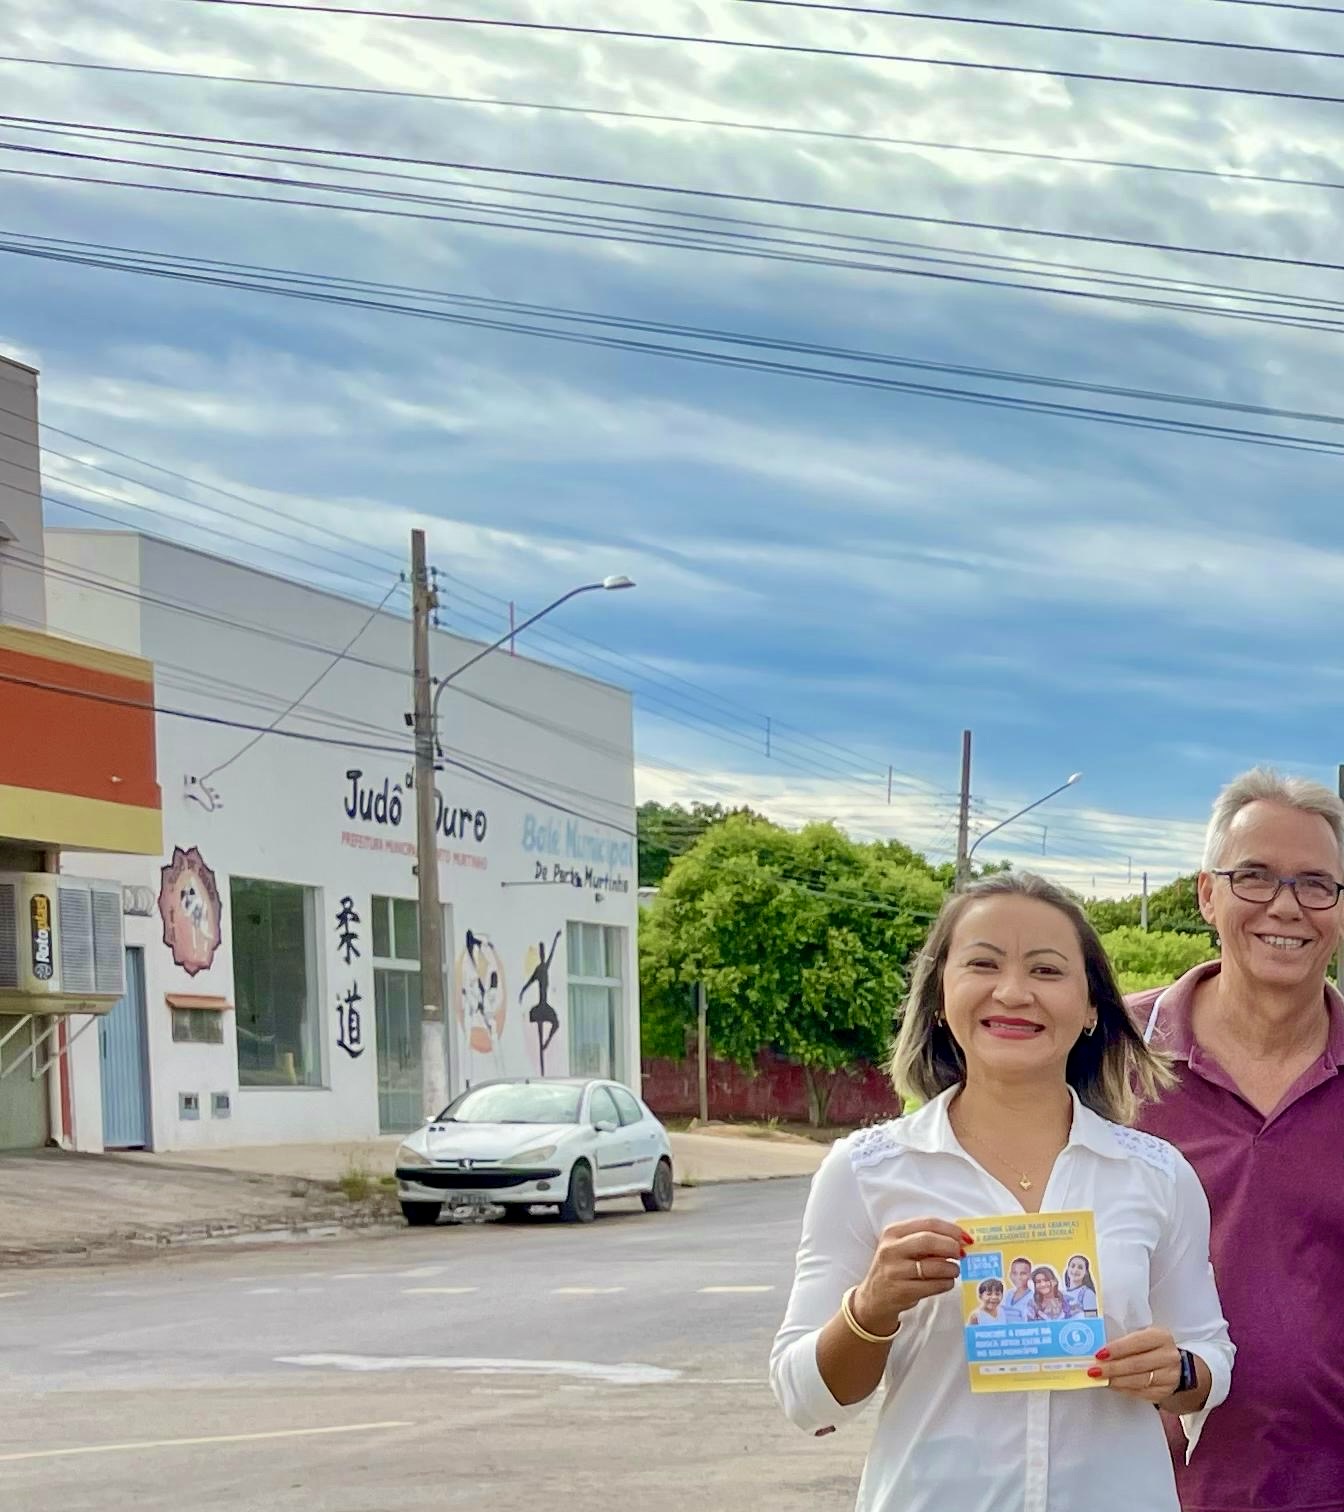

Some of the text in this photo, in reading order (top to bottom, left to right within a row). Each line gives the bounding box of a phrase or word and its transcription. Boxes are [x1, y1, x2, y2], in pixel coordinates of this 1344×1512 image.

[344, 769, 403, 826] Judô
[385, 839, 417, 858] MUNICIPA
[535, 860, 548, 881] De
[583, 865, 629, 893] Murtinho
